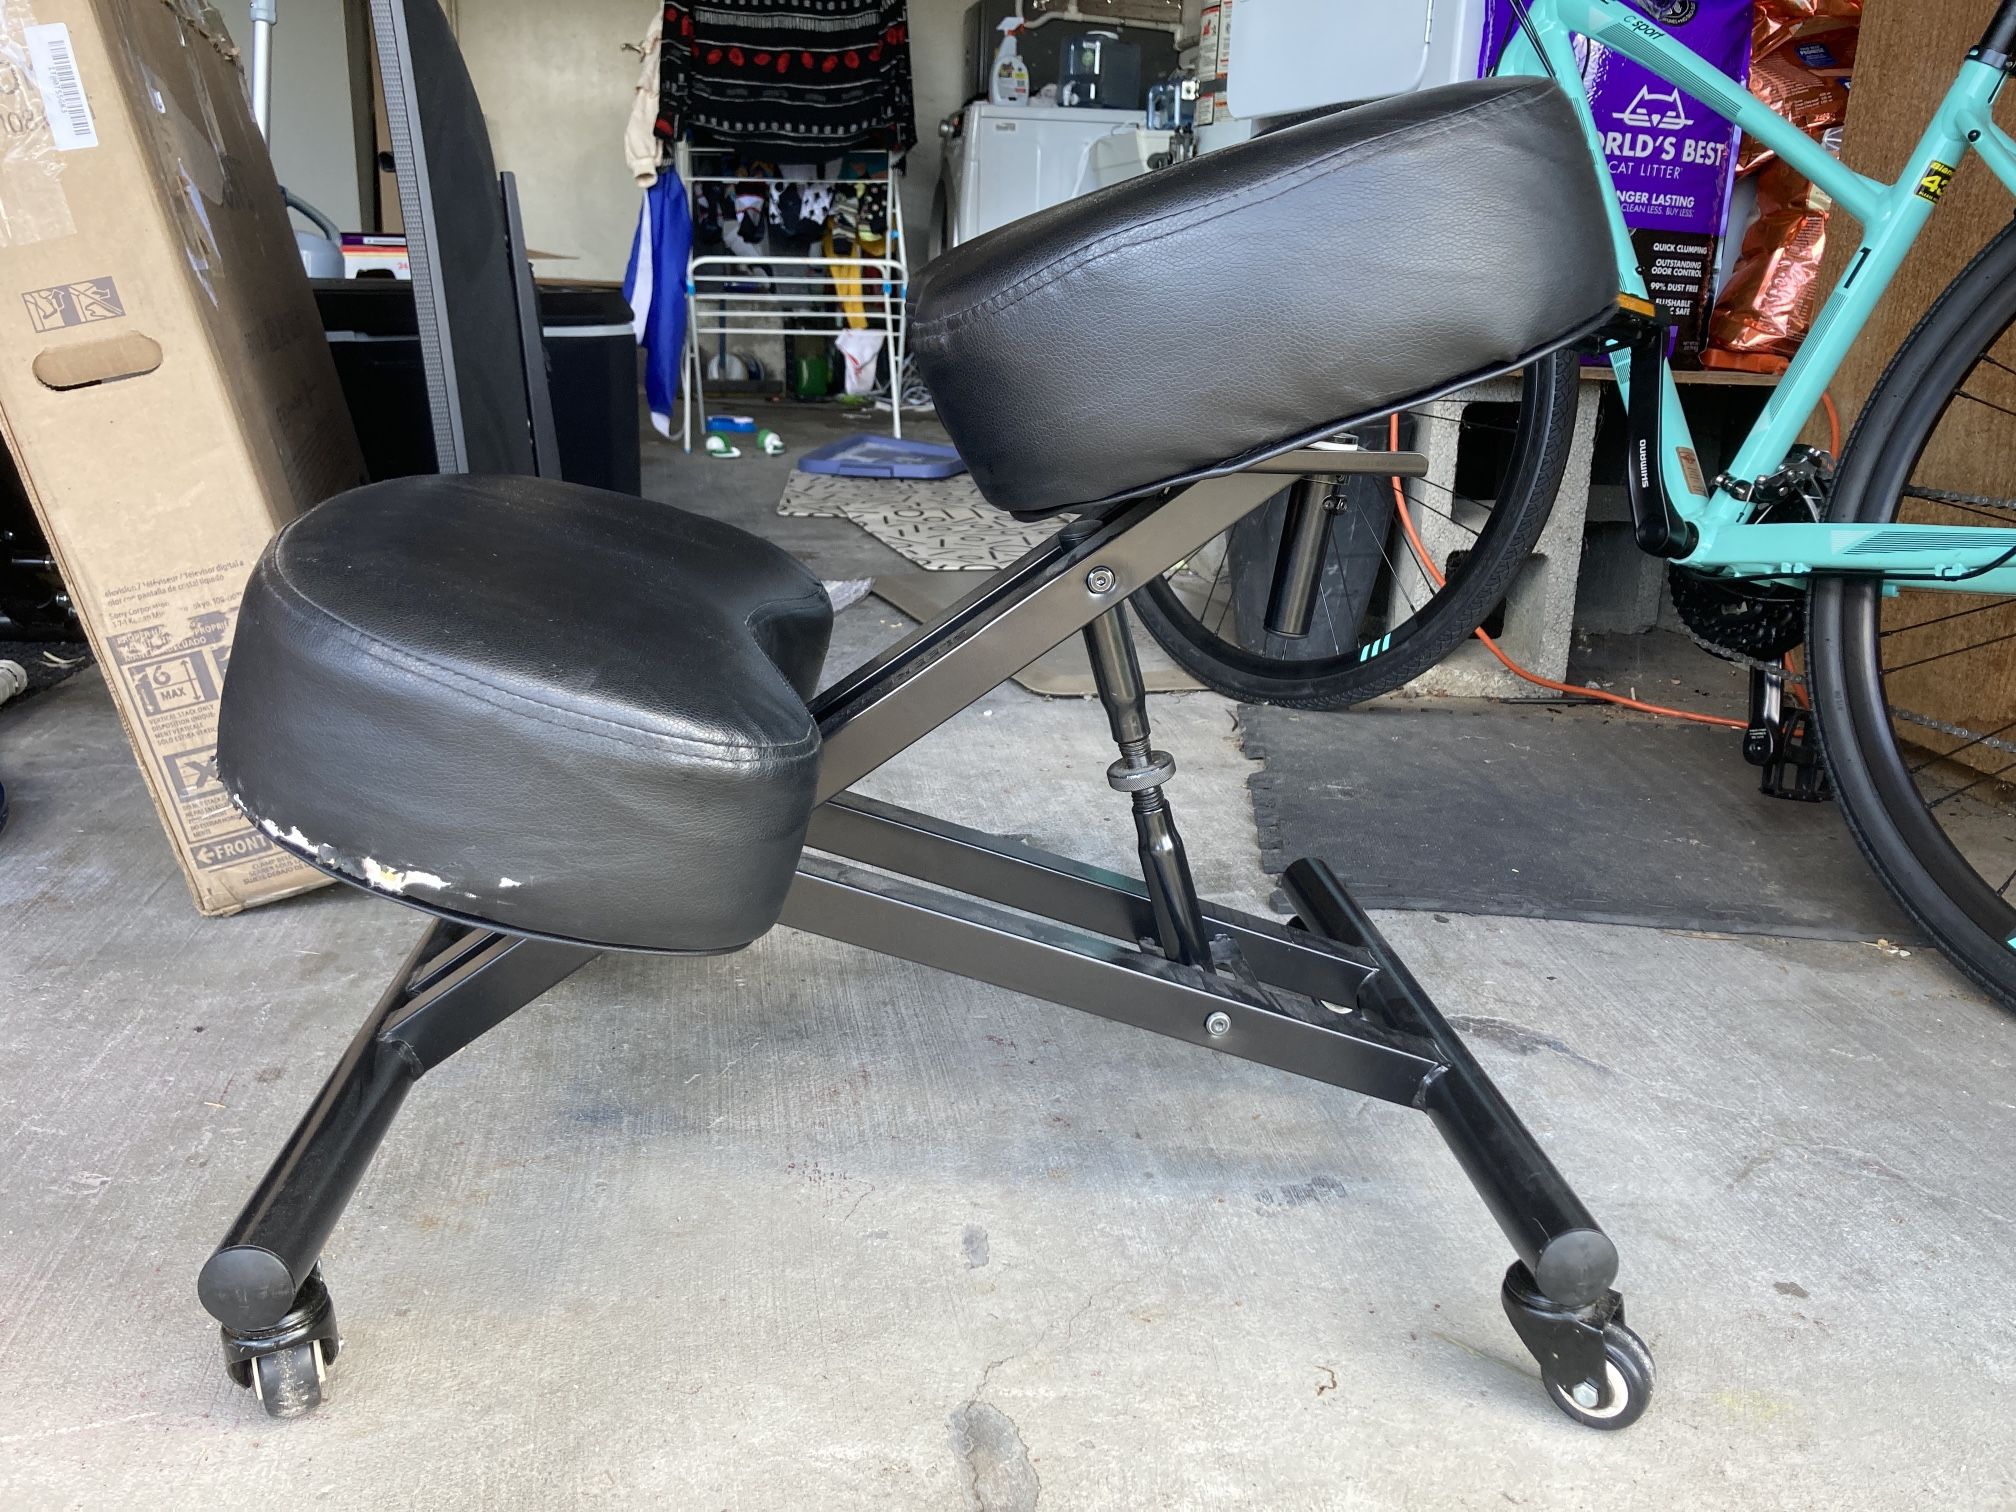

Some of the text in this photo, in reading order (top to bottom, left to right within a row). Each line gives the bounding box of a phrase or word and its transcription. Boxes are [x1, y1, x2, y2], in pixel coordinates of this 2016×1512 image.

[1632, 19, 1665, 40] sport
[1597, 131, 1725, 166] RLD'S BEST
[1608, 161, 1682, 179] CAT LITTER
[1616, 190, 1695, 208] NGER LASTING
[1621, 203, 1646, 212] CLEAN
[1666, 207, 1679, 216] BUY
[1653, 243, 1708, 255] QUICK CLUMPING
[1655, 258, 1702, 269] OUTSTANDING
[1651, 266, 1702, 278] ODOR CONTROL
[1650, 281, 1699, 293] 99% DUST FREE
[1675, 307, 1691, 316] SAFE
[1639, 438, 1649, 488] SHIMANO
[152, 664, 171, 685] 6
[160, 686, 187, 701] MAX
[197, 703, 215, 714] ONLY
[213, 834, 268, 860] FRONT
